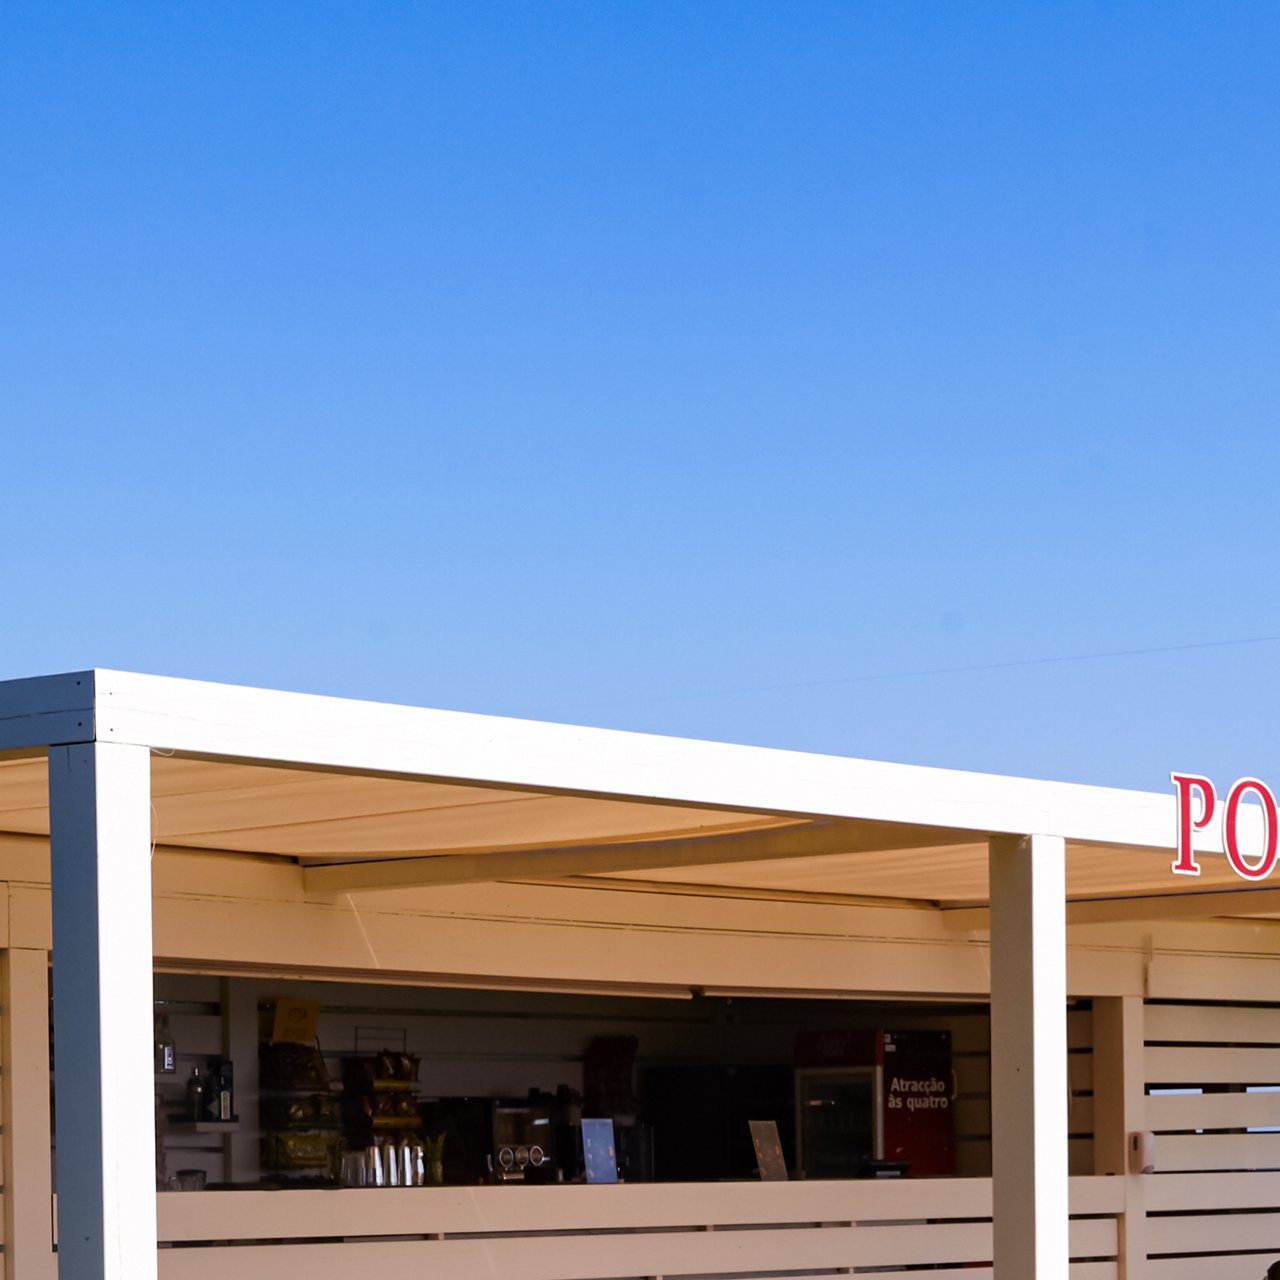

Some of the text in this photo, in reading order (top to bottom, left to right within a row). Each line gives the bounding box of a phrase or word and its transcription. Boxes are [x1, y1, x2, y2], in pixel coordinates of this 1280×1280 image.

[891, 1077, 945, 1094] Atracção
[888, 1093, 948, 1112] às quatro
